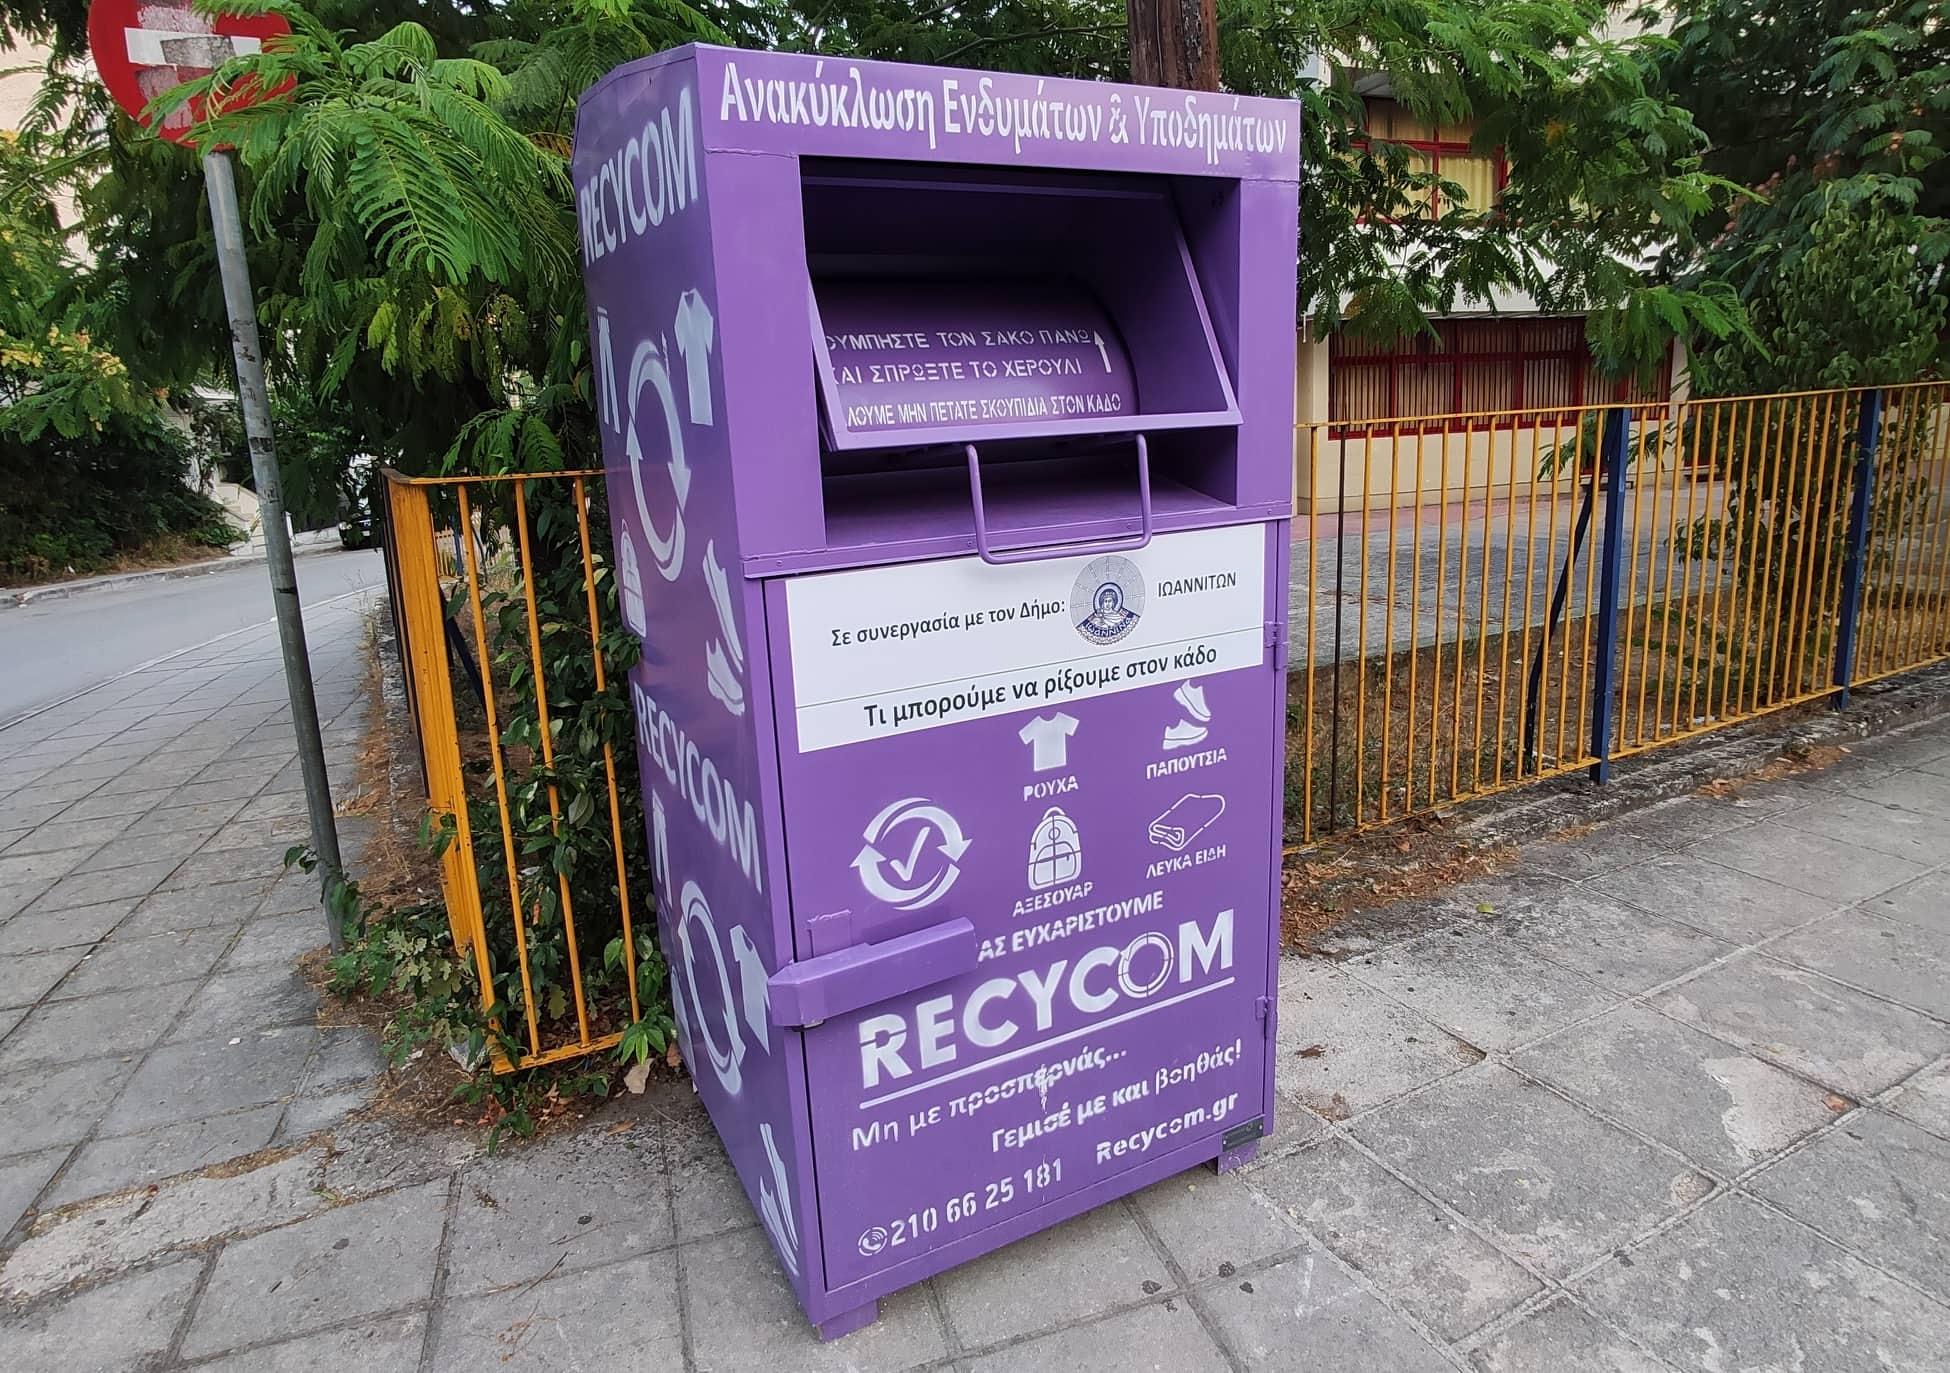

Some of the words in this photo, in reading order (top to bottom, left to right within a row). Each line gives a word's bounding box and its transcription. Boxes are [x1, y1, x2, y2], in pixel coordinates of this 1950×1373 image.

[720, 61, 935, 150] Ανακύκλωση
[943, 78, 1102, 154] Ενδυμάτων
[1110, 93, 1129, 144] &
[1134, 93, 1287, 165] Υποδημάτων
[580, 86, 699, 268] RECYCOM
[831, 366, 862, 385] ΑΙ
[870, 361, 966, 384] ΣΠΡΩΞΤΕ
[969, 360, 998, 378] ΤΟ
[1004, 358, 1082, 378] ΧΕΡΟΥΛΙ
[936, 331, 977, 347] ΤΟΝ
[982, 329, 1034, 346] ΣΑΚΟ
[1039, 328, 1091, 345] ΠΑΝΩ
[897, 402, 928, 424] ΜΗΝ
[930, 400, 978, 422] ΠΕΤΑΤΕ
[982, 397, 1048, 419] ΣΚΟΥΠΙΔΙΑ
[1050, 395, 1085, 415] ΣΤΟΝ
[1086, 393, 1121, 413] ΚΑΔΟ
[831, 628, 852, 647] Σε
[856, 614, 961, 642] συνεργασία
[964, 610, 985, 632] με
[988, 605, 1016, 621] τον
[1019, 596, 1066, 620] Δήμο:
[1157, 572, 1237, 599] ΙΩΑΝΝΙΤΩΝ
[863, 703, 887, 728] Τι
[892, 685, 1007, 728] μπορούμε
[1012, 681, 1039, 702] να
[1044, 662, 1121, 698] ρίξουμε
[1126, 658, 1168, 680] στον
[1173, 645, 1217, 671] κάδο
[634, 680, 762, 895] RECYCOM
[1023, 775, 1079, 801] ΡΟΥΧΑ
[1146, 748, 1228, 780] ΠΑΠΟΥΤΣΙΑ
[1146, 853, 1193, 879] ΛΕΥΚΑ
[1195, 844, 1227, 866] ΕΙΔΗ
[1012, 881, 1094, 918] ΑΞΕΣΟΥΑΡ
[1012, 890, 1164, 952] ΕΥΧΑΡΙΣΤΟΥΜΕ
[859, 908, 1235, 1089] RECYCOM
[852, 1120, 899, 1151] Μη
[910, 1105, 941, 1134] με
[992, 1102, 1071, 1152] Γεμισέ
[1077, 1094, 1106, 1125] με
[1112, 1079, 1149, 1106] και
[1155, 1038, 1242, 1096] βοηθάς!
[1096, 1090, 1239, 1165] Recycom.gr
[890, 1207, 938, 1246] 210
[946, 1192, 976, 1225] 66
[985, 1181, 1014, 1209] 25
[1023, 1158, 1062, 1193] 181
